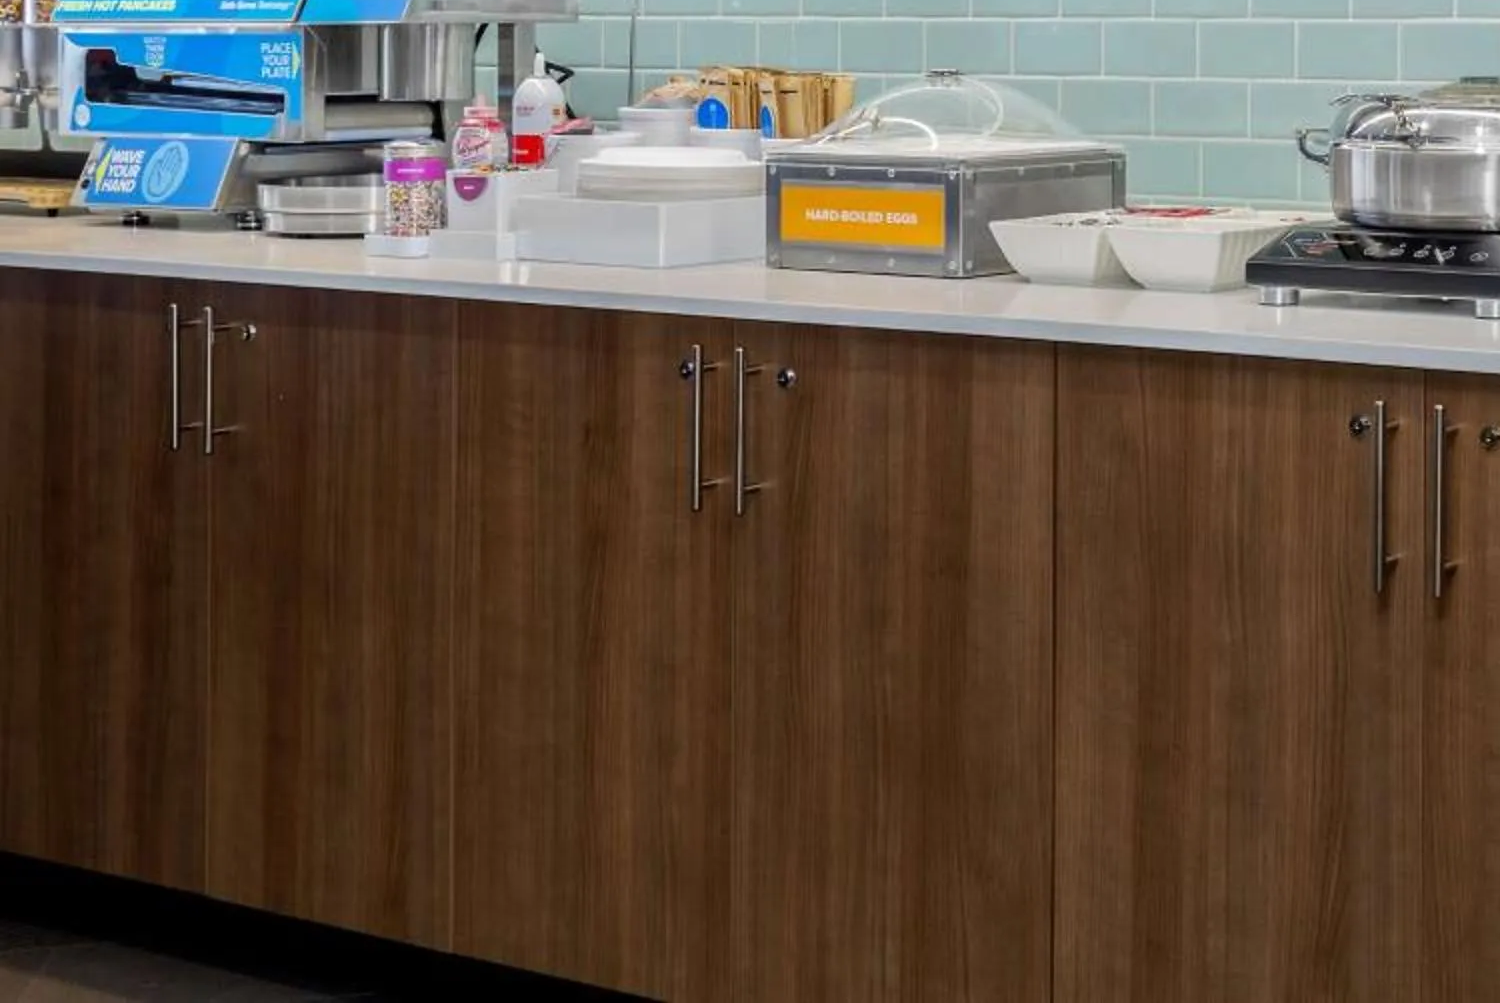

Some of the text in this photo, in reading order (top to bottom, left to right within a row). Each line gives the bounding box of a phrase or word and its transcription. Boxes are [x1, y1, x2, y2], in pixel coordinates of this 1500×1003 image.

[260, 42, 291, 53] PLACE
[262, 55, 289, 65] YOUR
[261, 67, 290, 78] PLATE
[111, 148, 146, 163] WAVE
[109, 164, 142, 178] YOUR
[101, 178, 137, 193] HAND
[805, 208, 918, 225] HARD-BOILED EGGS
